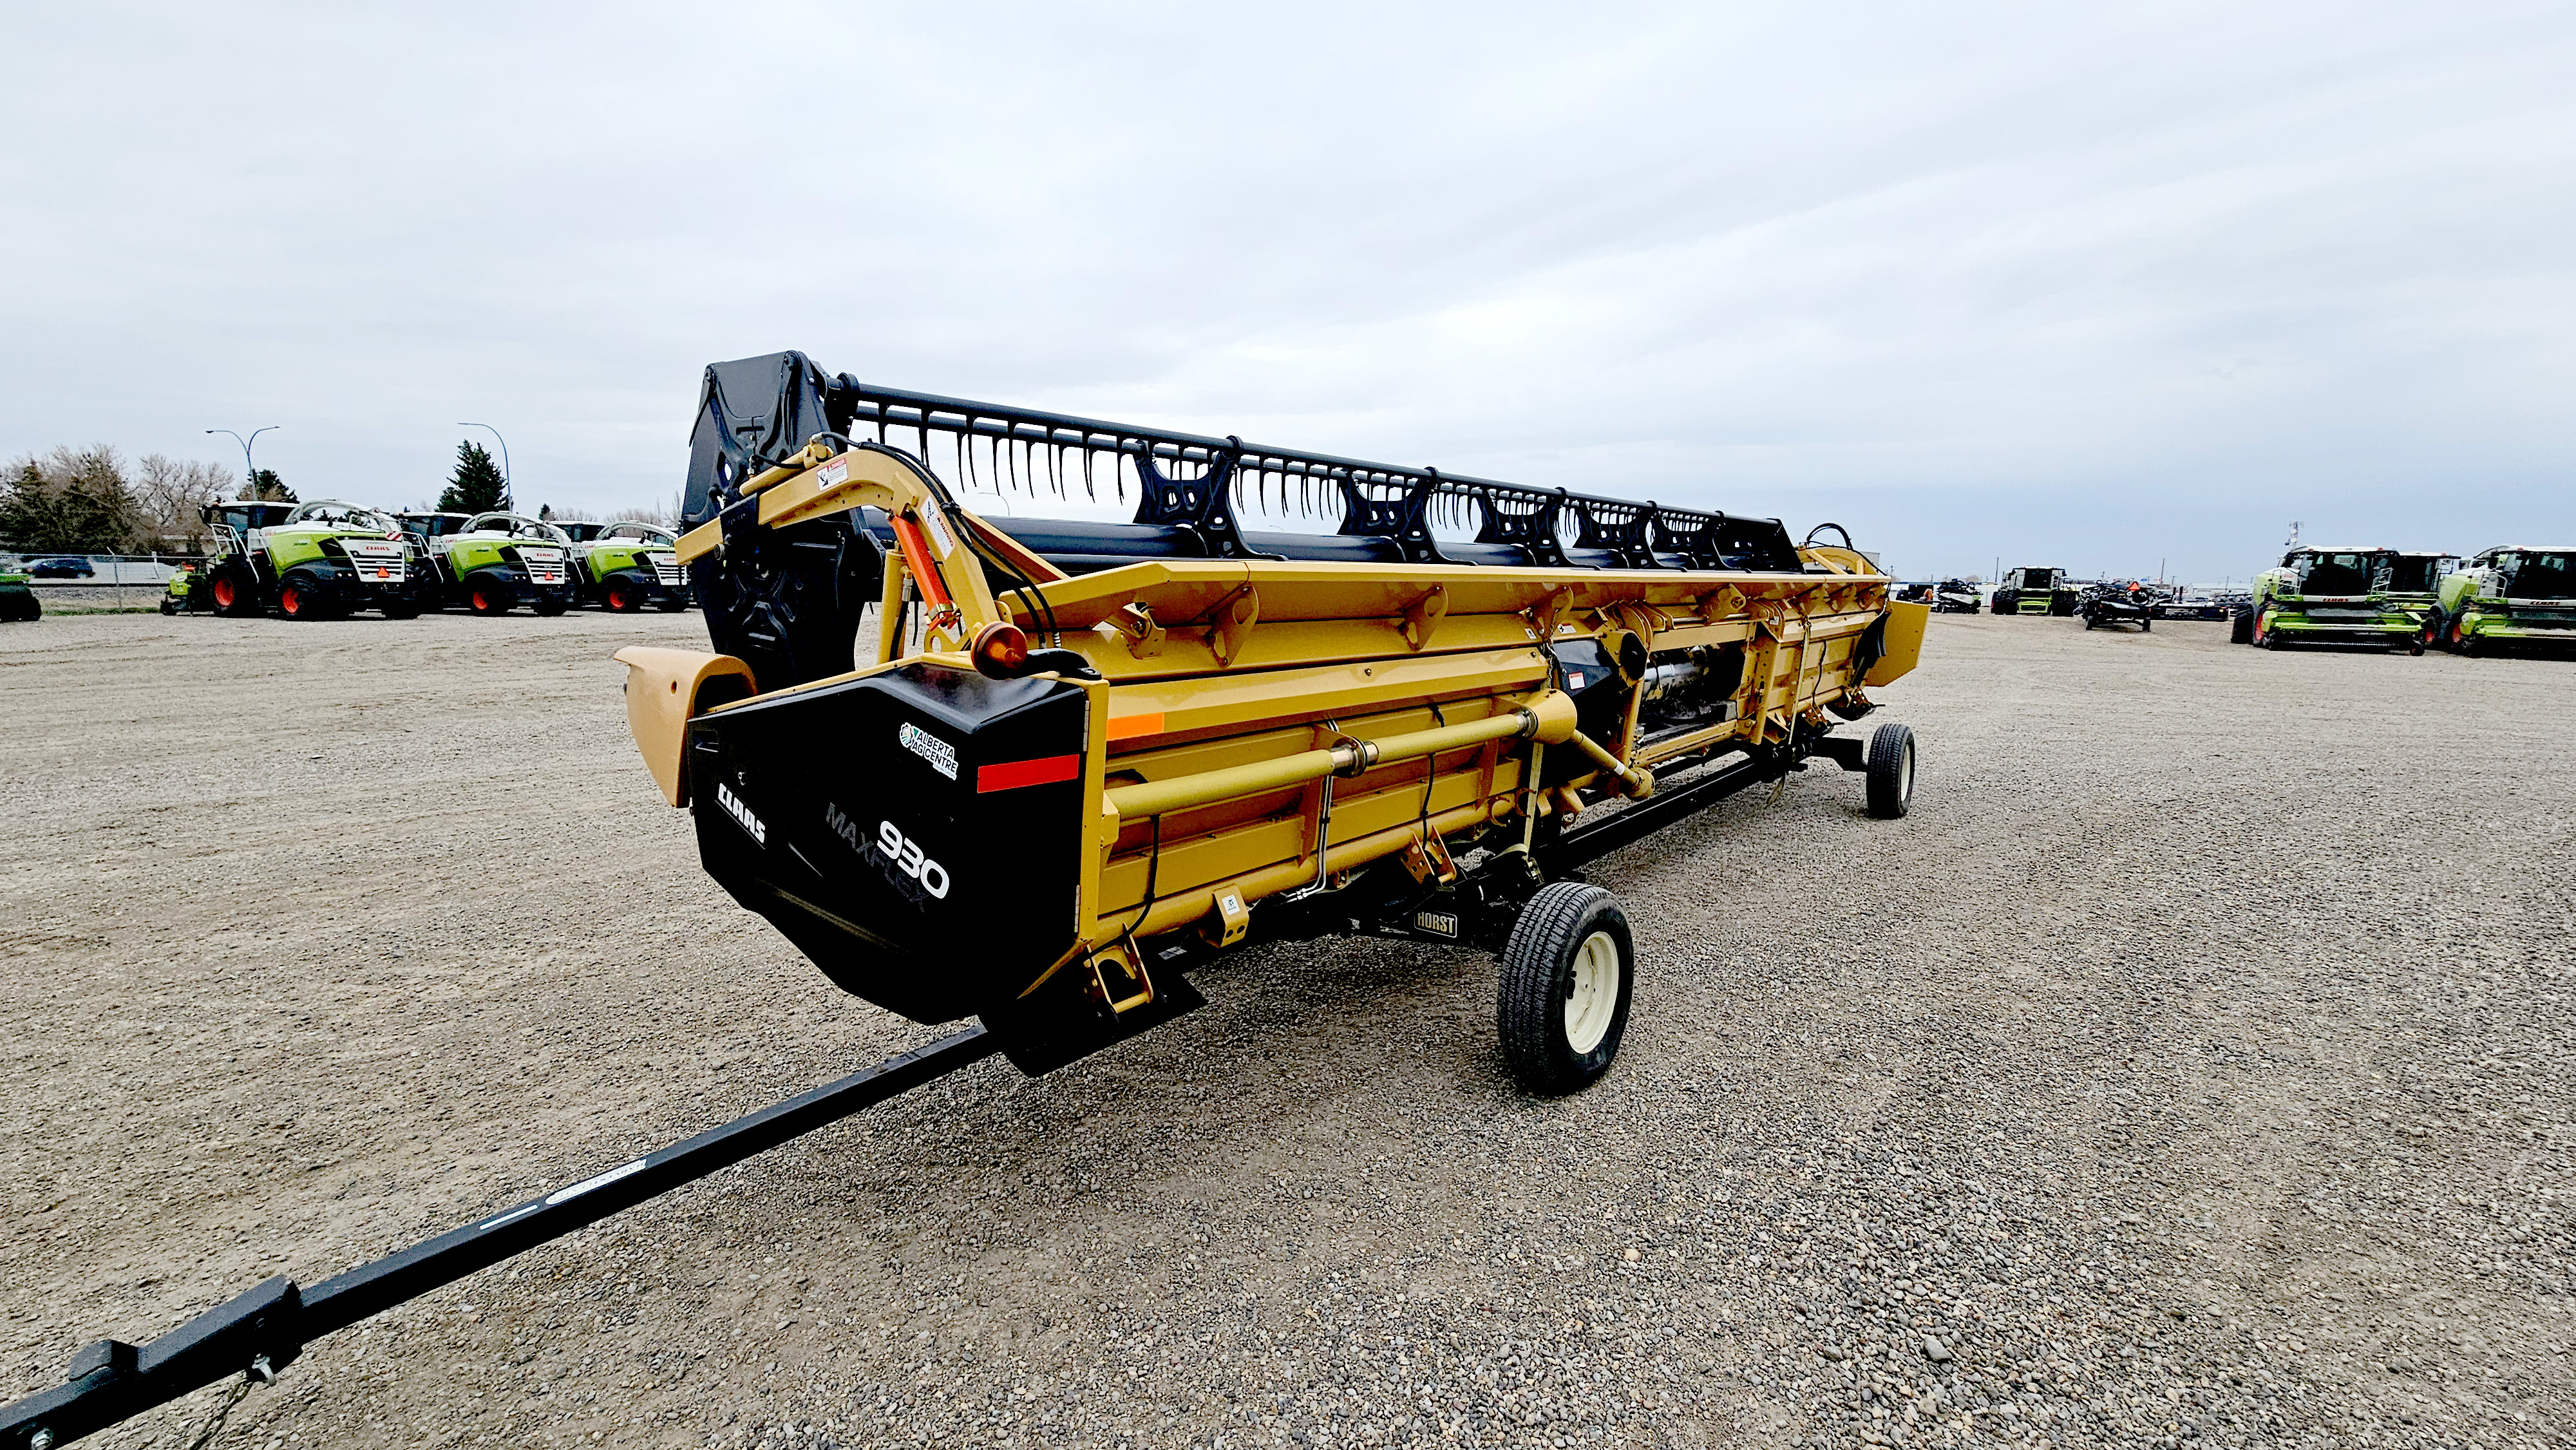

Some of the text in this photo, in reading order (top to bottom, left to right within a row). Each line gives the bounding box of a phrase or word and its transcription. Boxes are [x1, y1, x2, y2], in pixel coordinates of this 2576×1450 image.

[912, 741, 923, 754] AG
[925, 748, 957, 773] CENTRE
[916, 731, 954, 759] ALBERTA
[718, 783, 766, 843] CLAAS
[826, 802, 930, 913] MAXFLEX
[876, 820, 950, 899] 930
[1417, 911, 1455, 934] HORST
